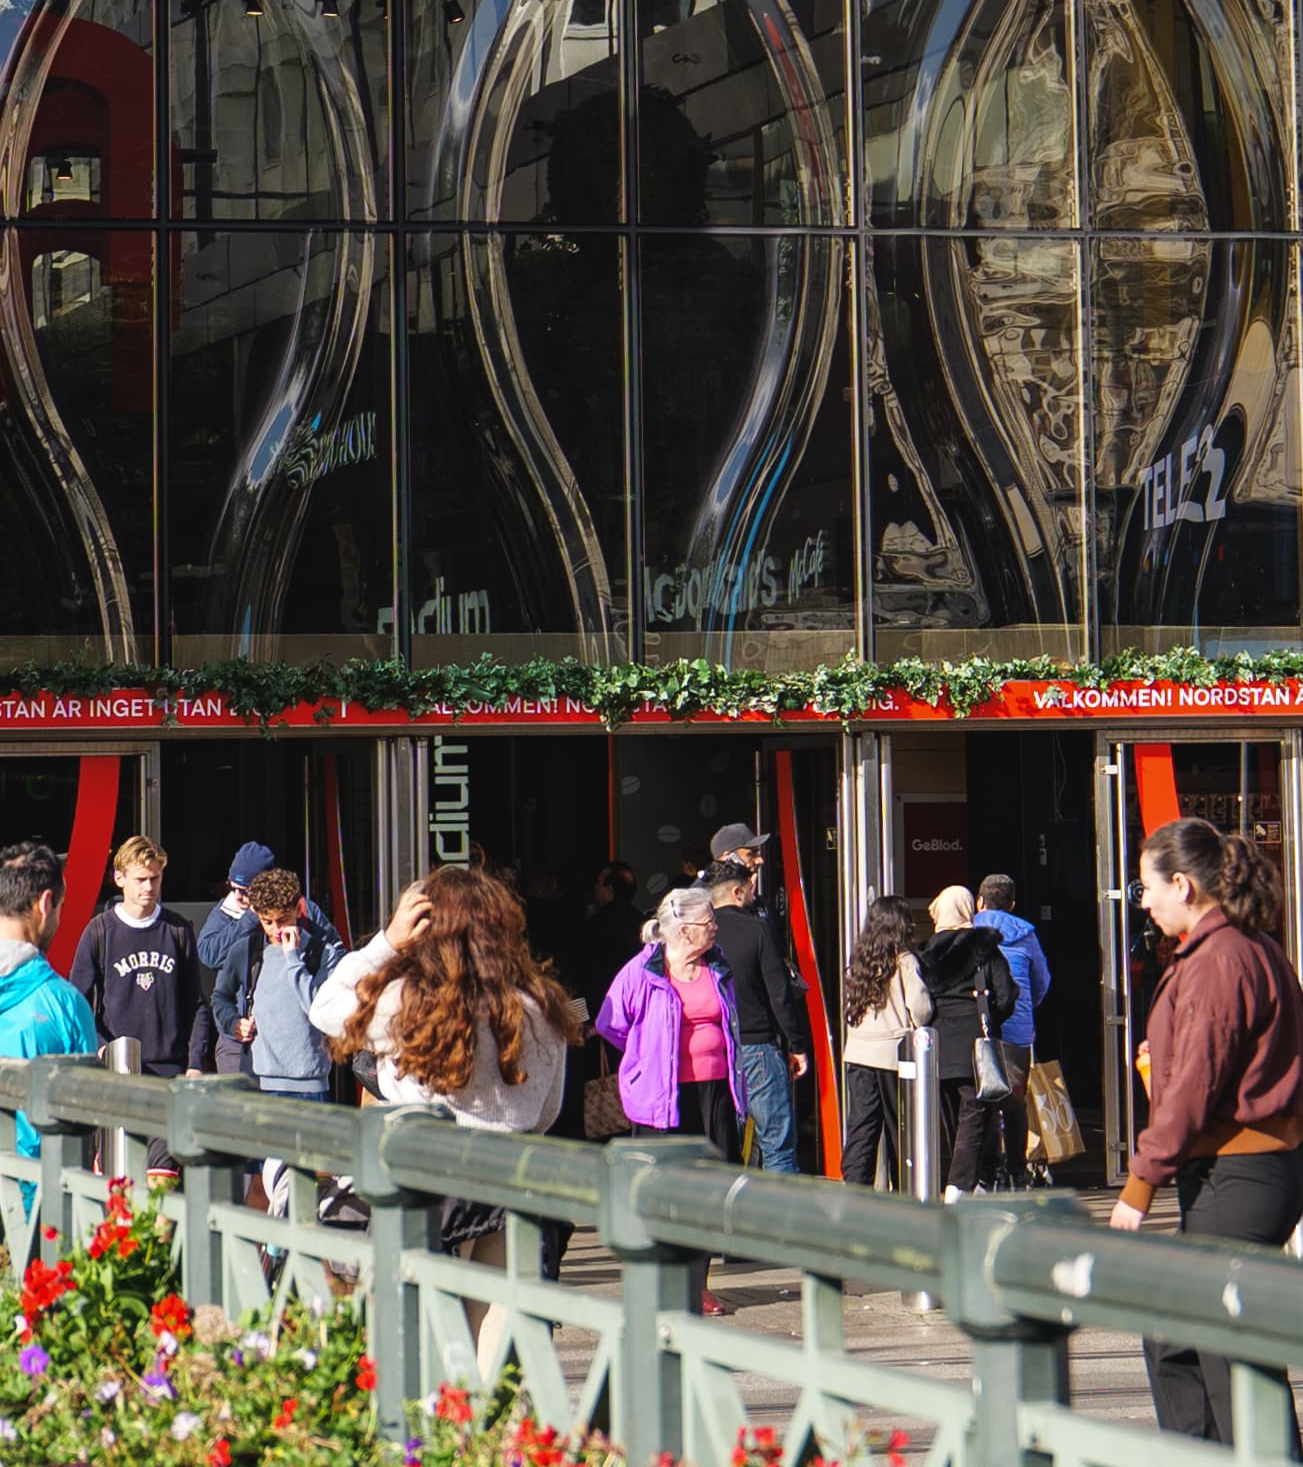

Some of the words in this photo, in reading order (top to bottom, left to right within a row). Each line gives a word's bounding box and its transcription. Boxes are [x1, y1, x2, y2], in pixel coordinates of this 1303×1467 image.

[1139, 423, 1227, 532] TELE2
[89, 697, 154, 718] INGET
[1178, 686, 1291, 706] NORDSTAN
[428, 735, 470, 871] dium
[911, 838, 964, 852] GeBlod.
[113, 951, 176, 978] MORRIS
